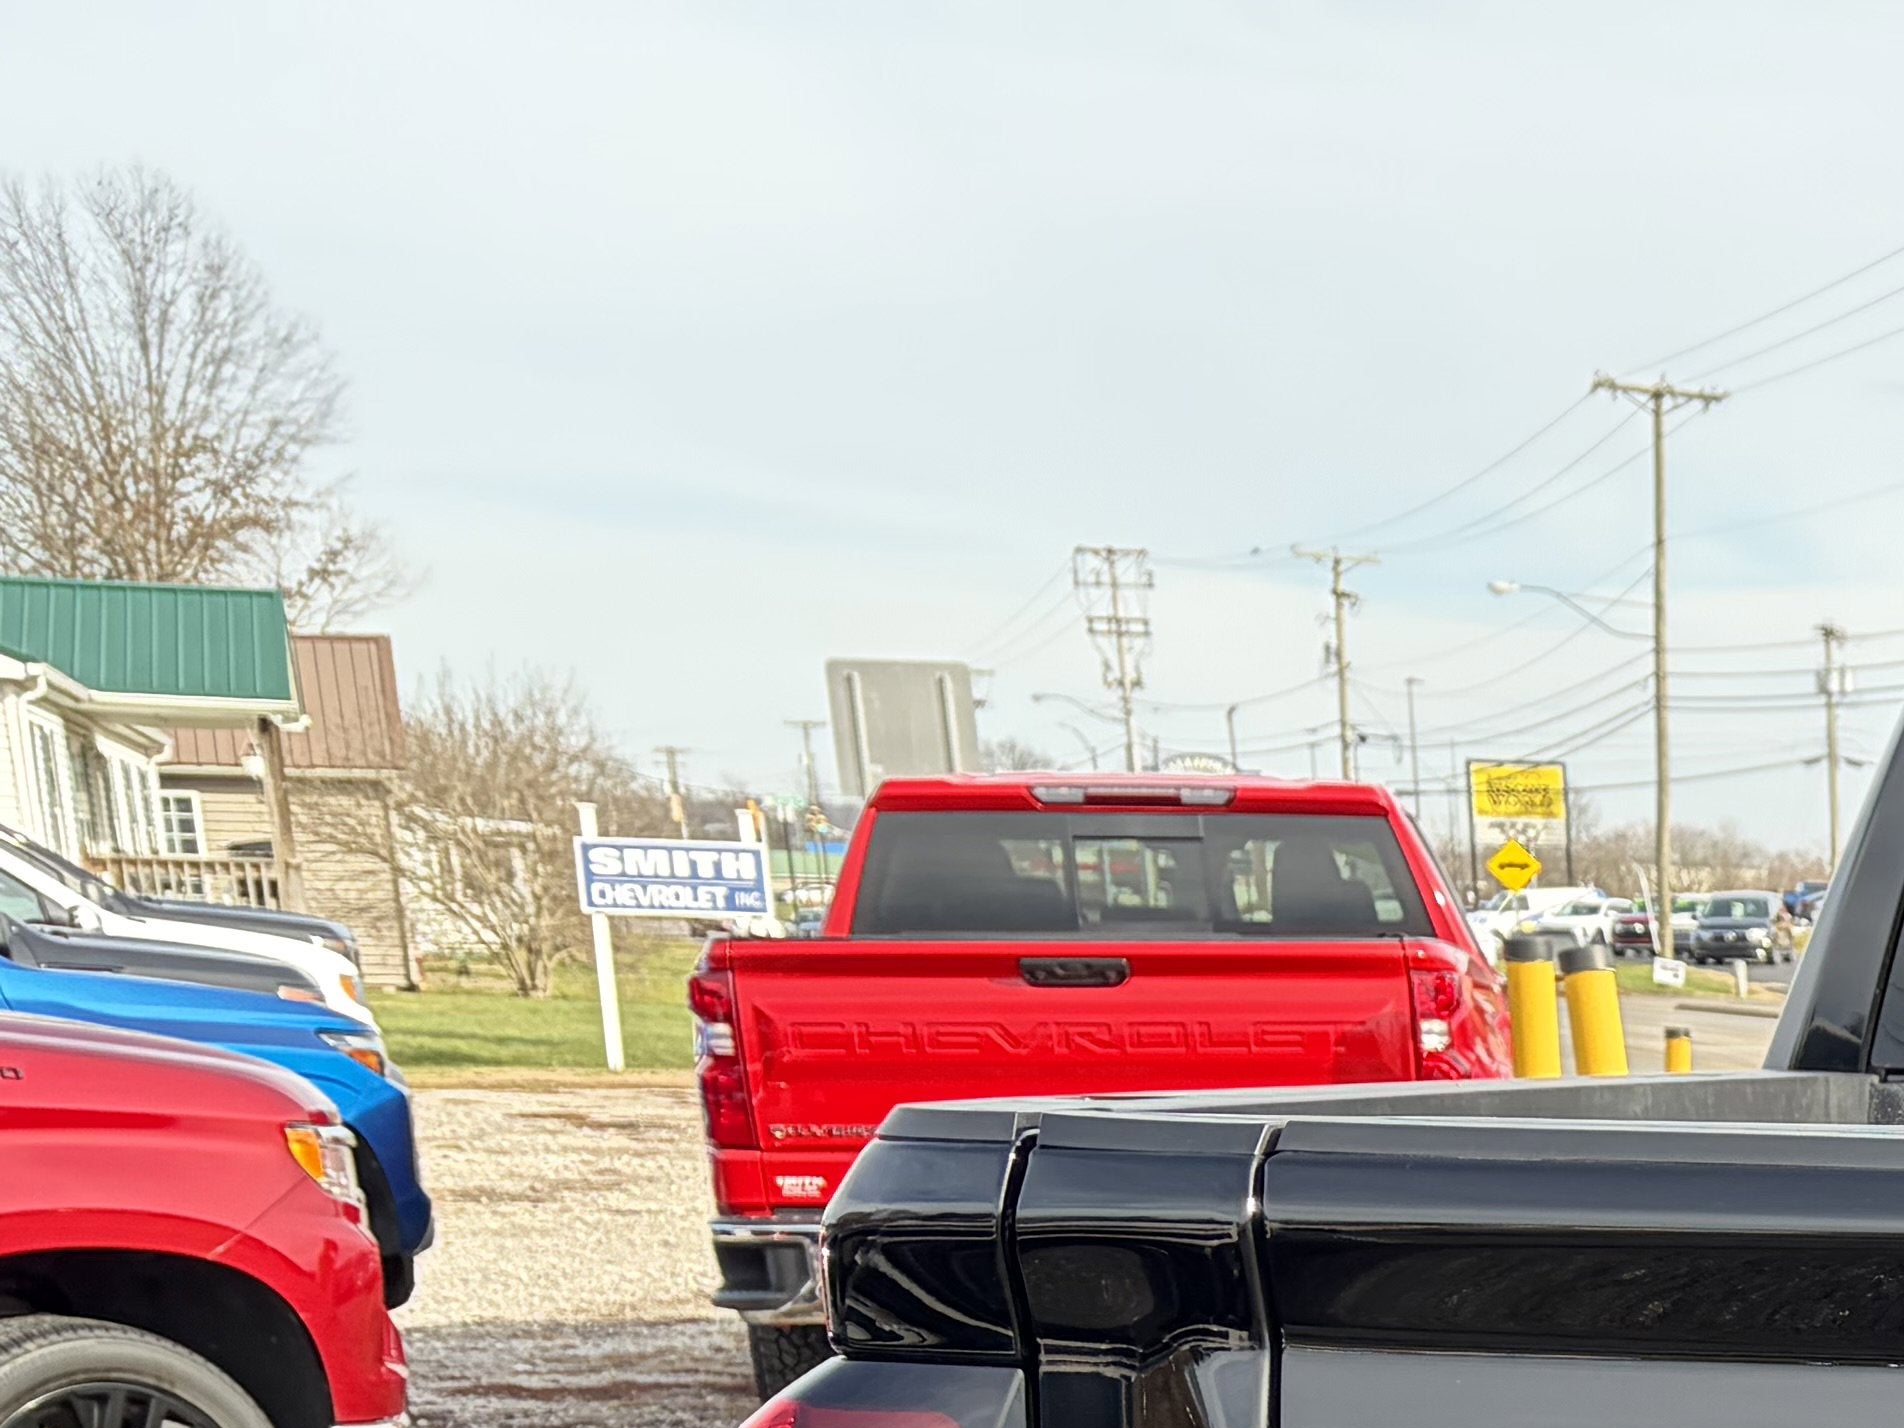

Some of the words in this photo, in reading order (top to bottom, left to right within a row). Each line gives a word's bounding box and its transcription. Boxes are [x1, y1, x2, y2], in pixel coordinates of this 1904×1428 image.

[588, 847, 757, 880] SMITH
[590, 882, 729, 909] CHEVROLET
[787, 1020, 1372, 1056] CHEVROLET
